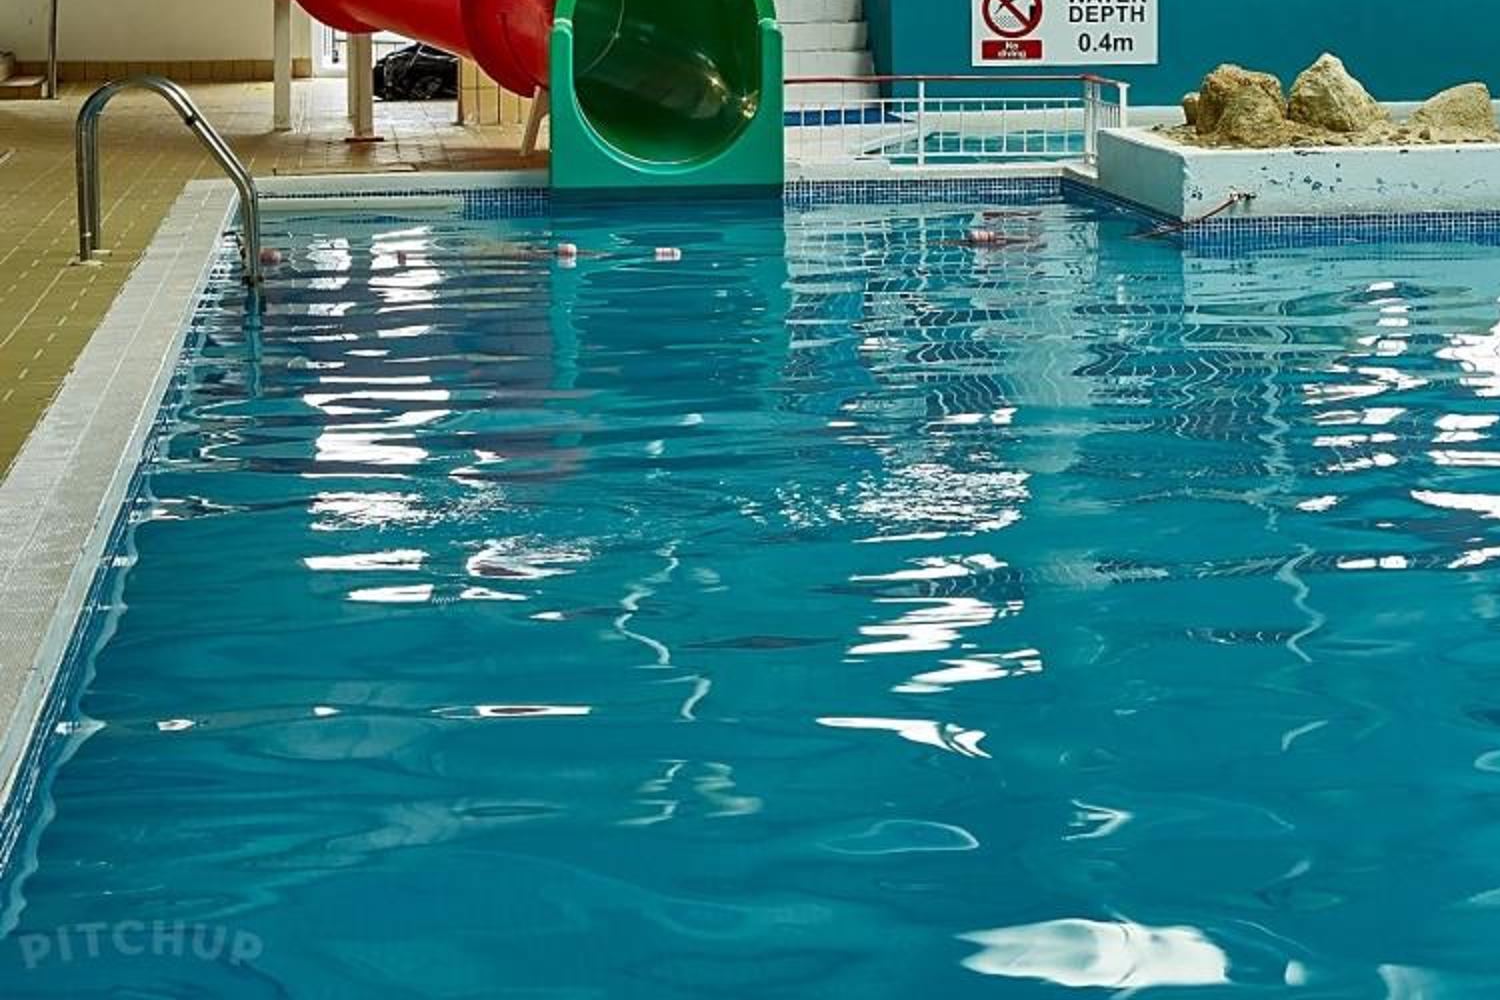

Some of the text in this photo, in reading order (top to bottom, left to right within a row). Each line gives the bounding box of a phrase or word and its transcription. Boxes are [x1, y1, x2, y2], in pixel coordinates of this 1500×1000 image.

[1069, 6, 1145, 23] DEPTH
[1005, 42, 1019, 50] No
[1078, 33, 1134, 52] 0.4m
[997, 50, 1027, 59] diving
